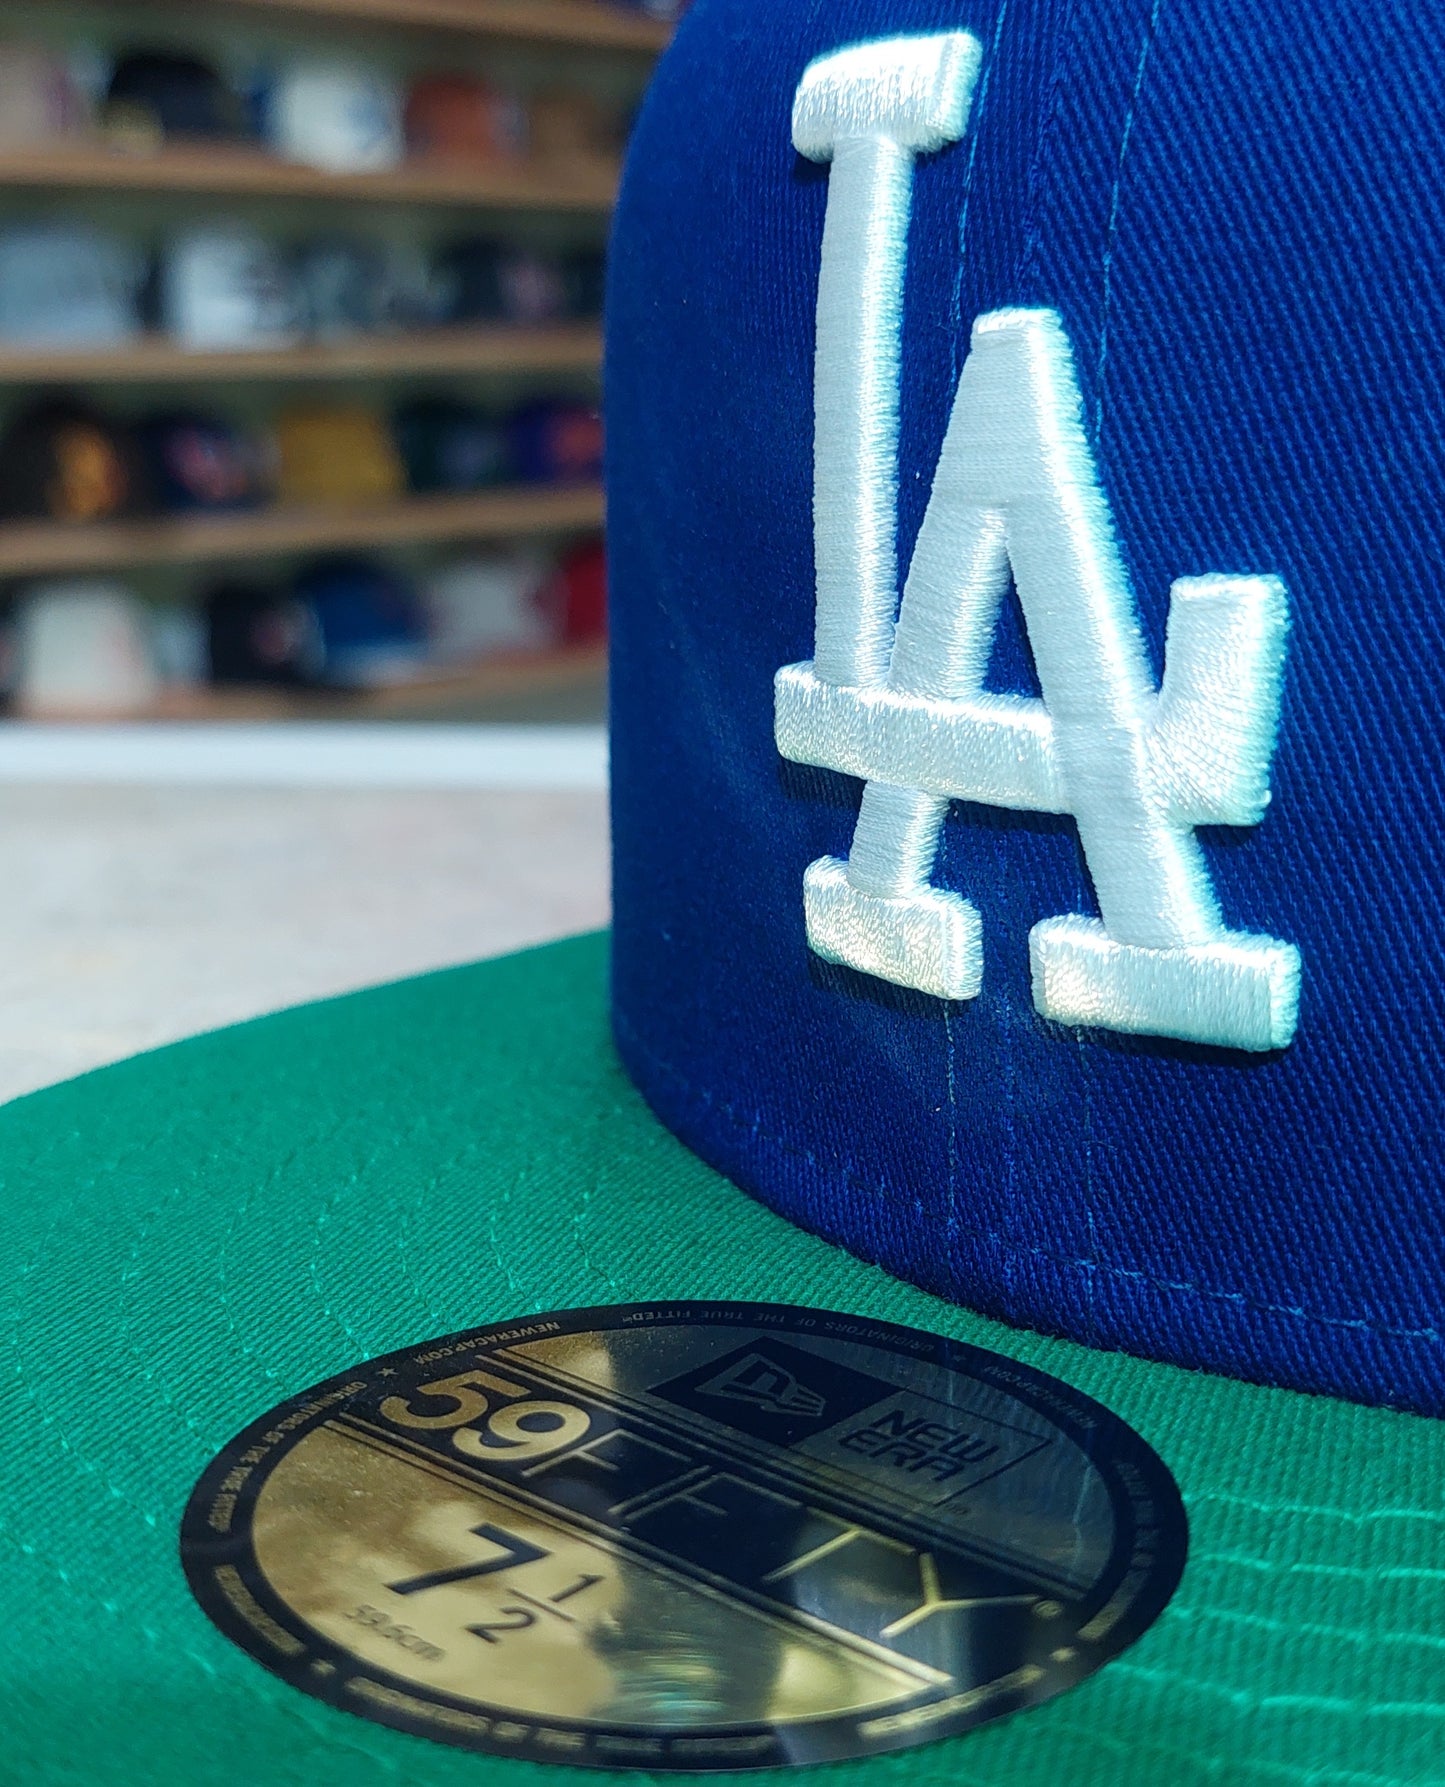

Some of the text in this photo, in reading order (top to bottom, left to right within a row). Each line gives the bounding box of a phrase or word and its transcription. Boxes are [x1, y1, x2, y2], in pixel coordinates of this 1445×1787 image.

[774, 29, 1302, 1053] LA
[415, 1320, 561, 1365] NEWERACAP.COM
[837, 1427, 967, 1483] ERA
[869, 1409, 1000, 1464] NEW
[383, 1522, 551, 1596] 7
